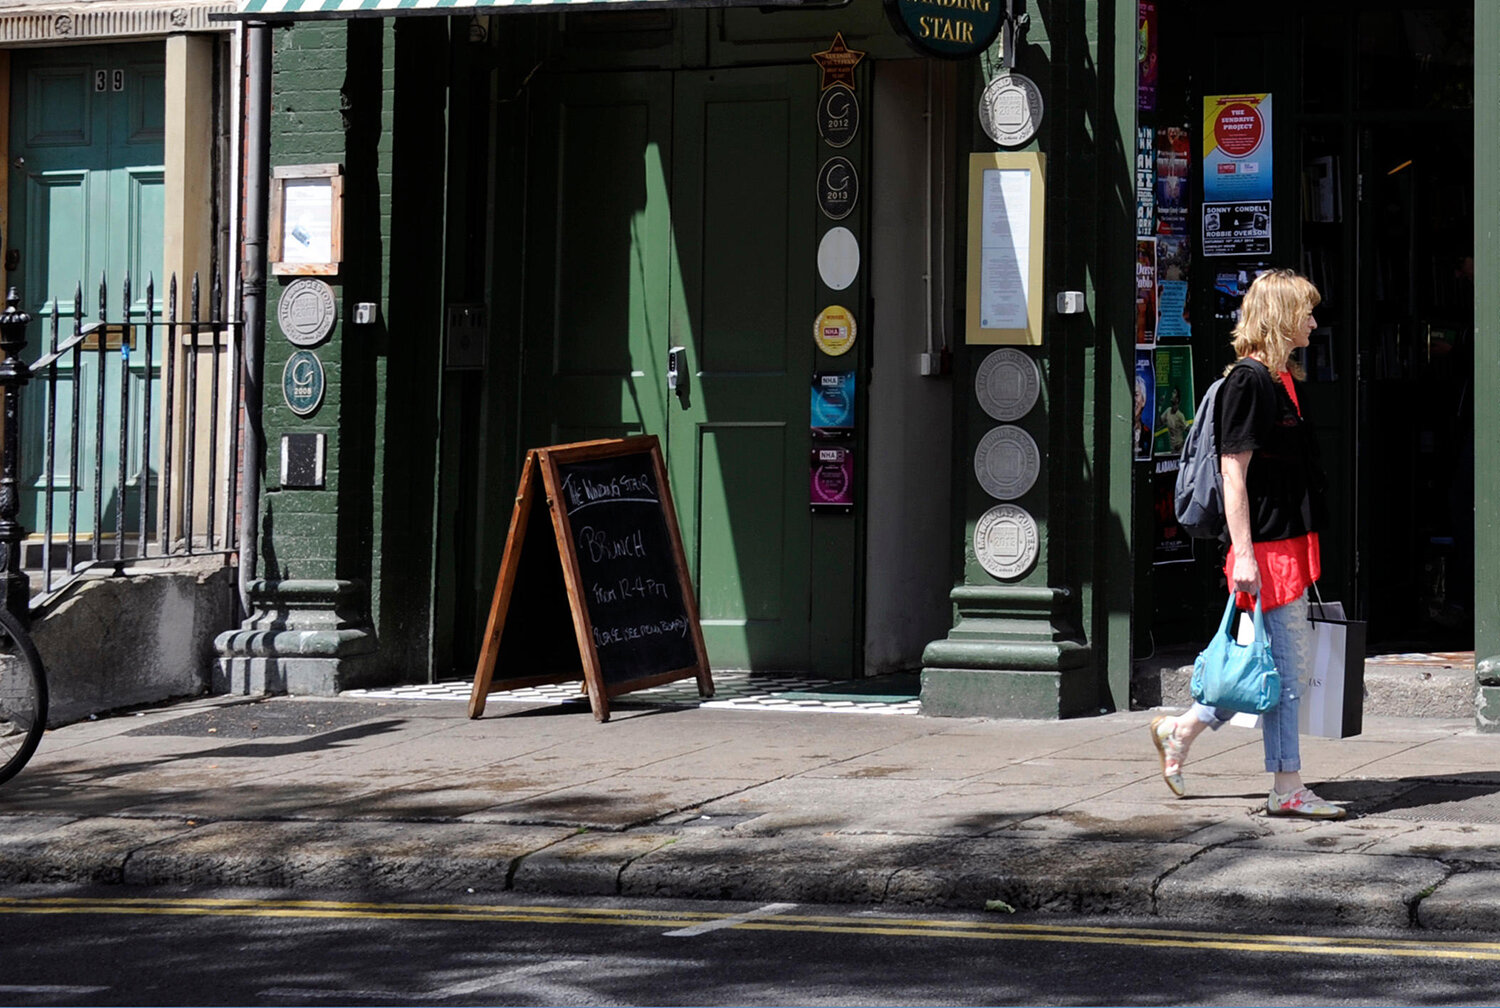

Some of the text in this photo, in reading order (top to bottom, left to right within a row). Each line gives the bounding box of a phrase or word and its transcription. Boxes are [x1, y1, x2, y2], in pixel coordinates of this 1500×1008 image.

[919, 16, 975, 44] STAIR
[96, 70, 123, 91] 39
[827, 118, 849, 129] 2012
[1221, 116, 1255, 124] SUNDRIVE
[1223, 123, 1253, 131] PROJECT
[826, 191, 848, 201] 2013
[1234, 205, 1268, 213] CONDELL
[1233, 229, 1268, 237] OVERSON
[822, 377, 838, 385] NHA
[821, 451, 837, 459] NHA
